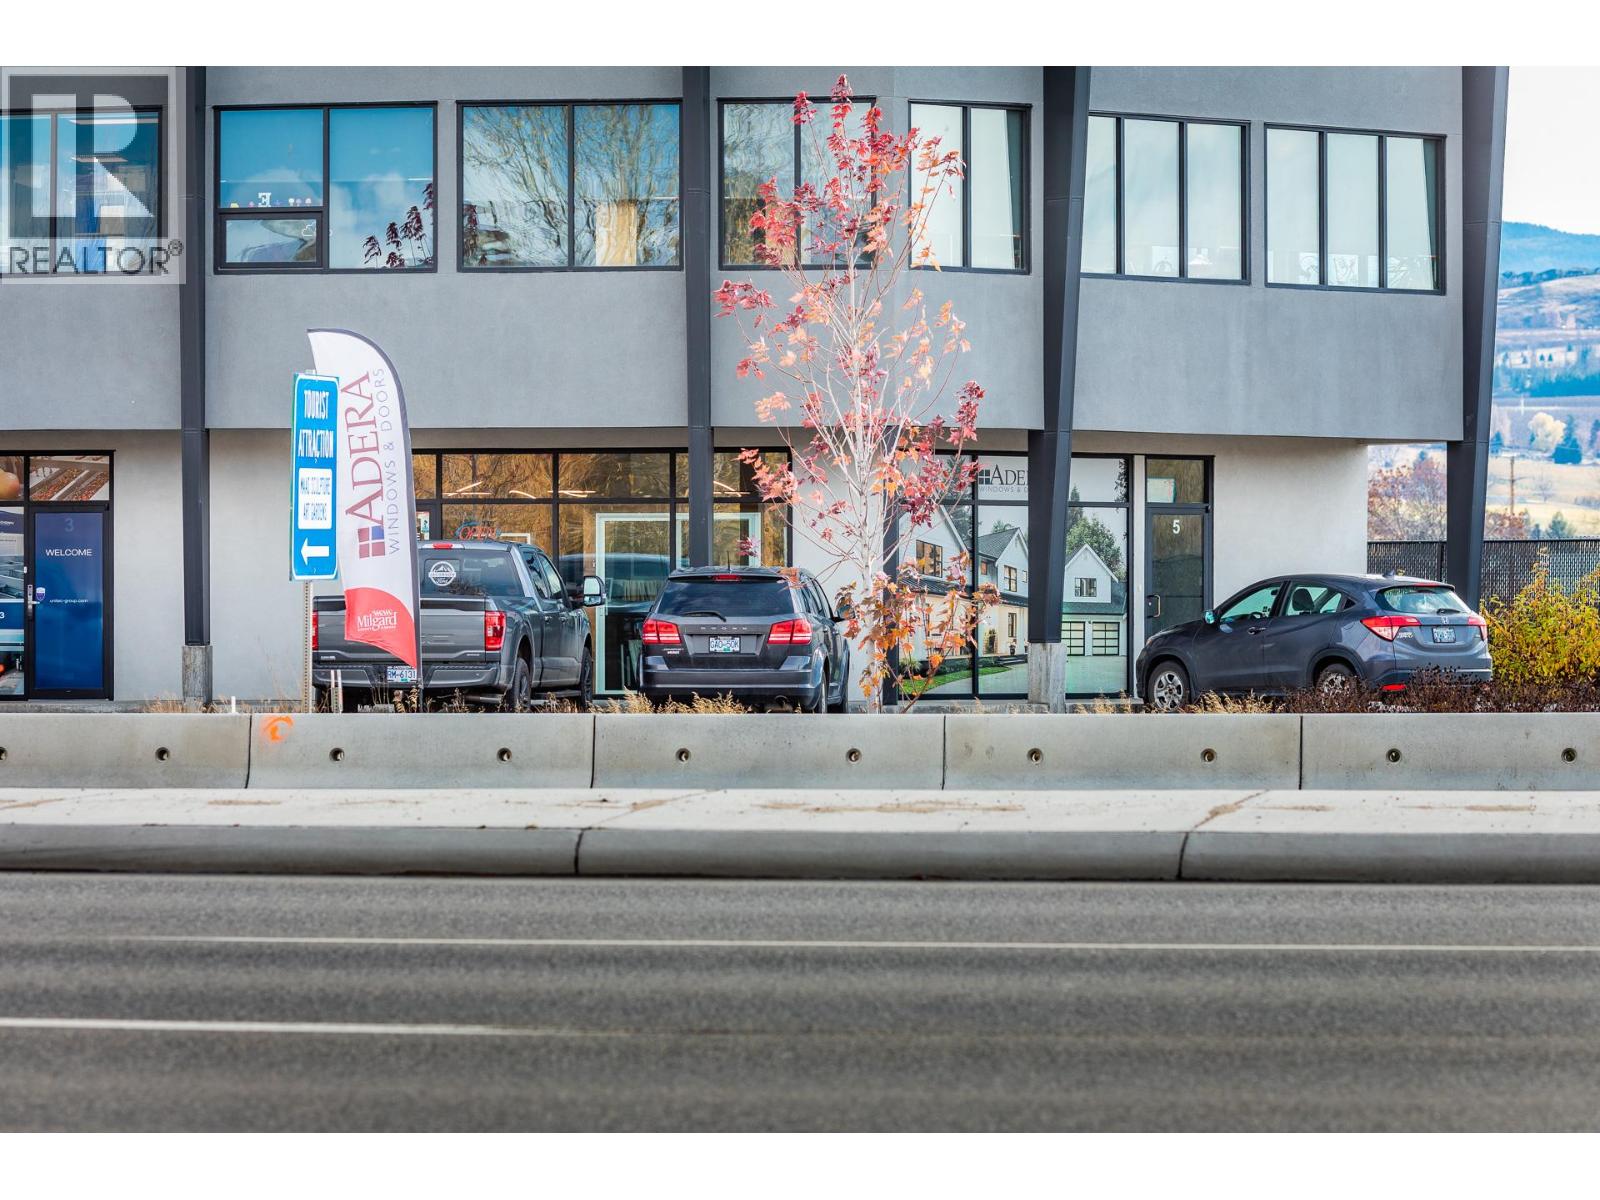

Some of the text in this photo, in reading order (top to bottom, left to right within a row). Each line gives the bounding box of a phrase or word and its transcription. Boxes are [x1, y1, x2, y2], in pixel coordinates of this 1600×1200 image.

[304, 389, 330, 420] TOURIST
[373, 368, 393, 432] DOORS
[297, 429, 334, 458] ATTRACTION
[340, 371, 385, 529] ADERA
[990, 464, 1029, 486] ADE
[385, 460, 400, 555] WINDOWS
[64, 517, 76, 533] 3
[1172, 519, 1181, 534] 5
[45, 548, 93, 557] WELCOME
[357, 611, 398, 632] Milgard
